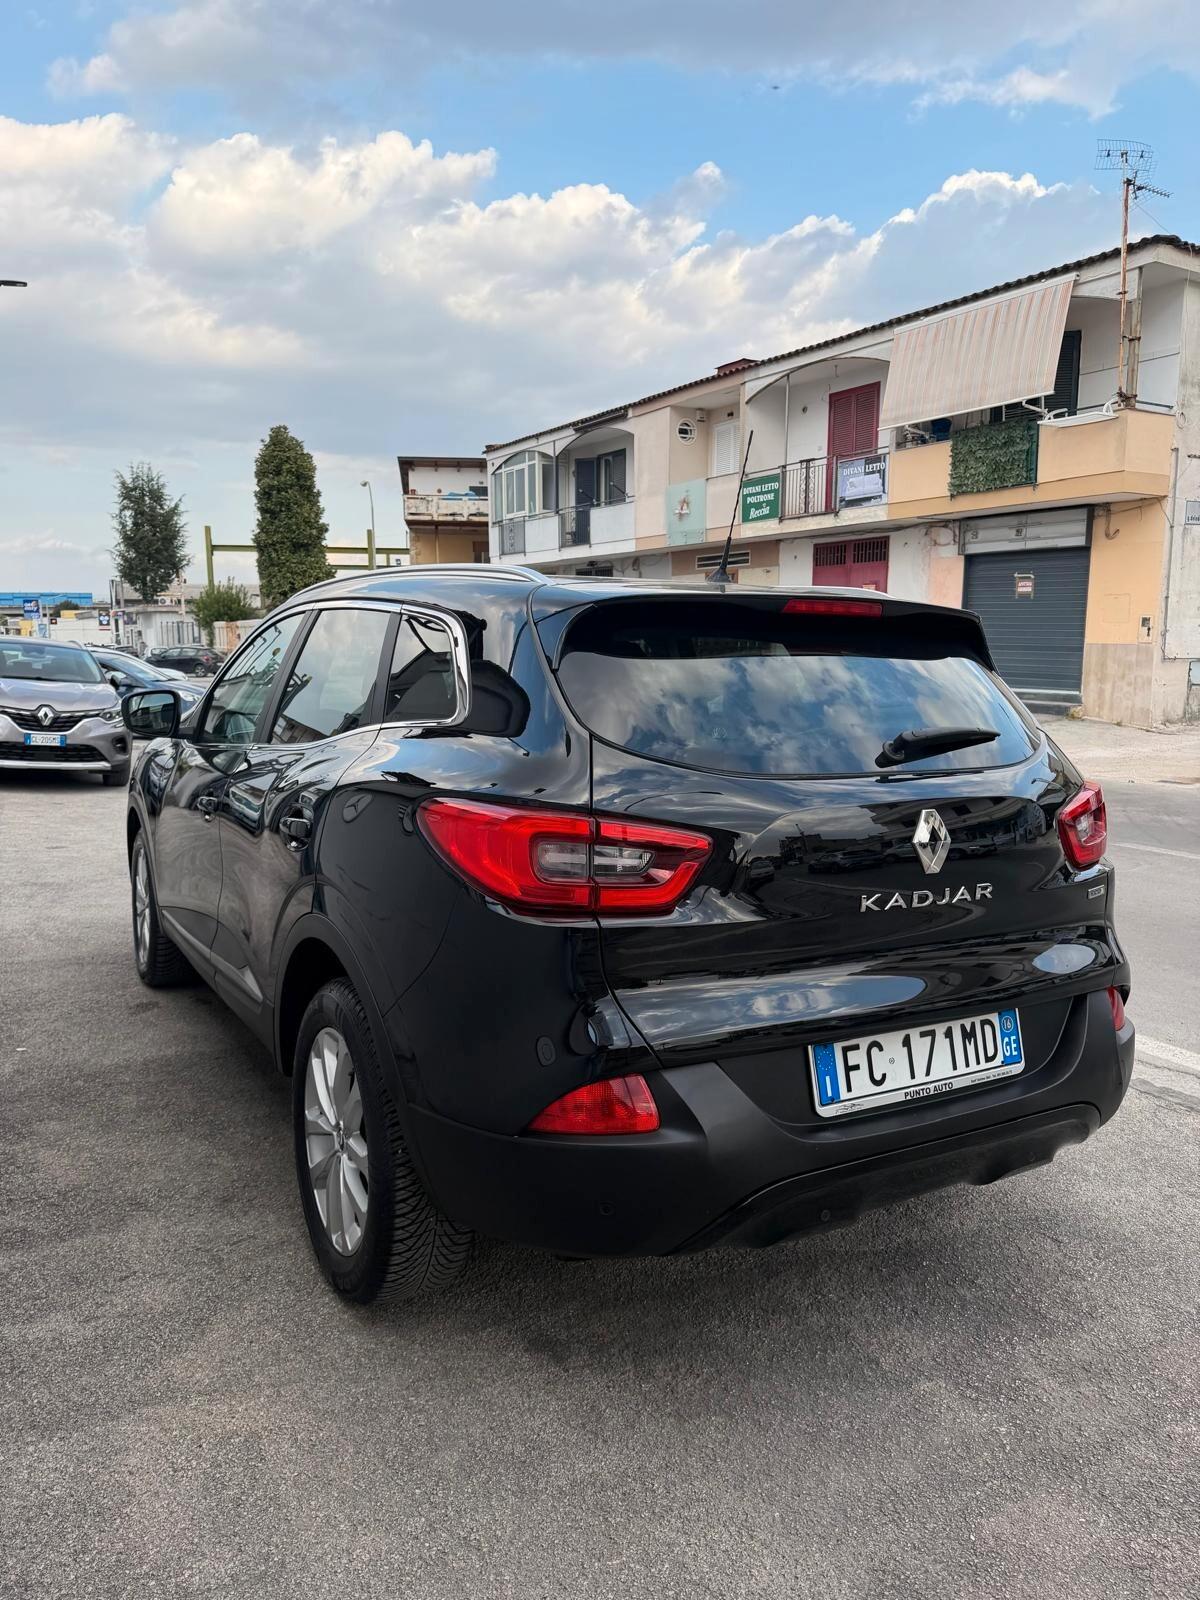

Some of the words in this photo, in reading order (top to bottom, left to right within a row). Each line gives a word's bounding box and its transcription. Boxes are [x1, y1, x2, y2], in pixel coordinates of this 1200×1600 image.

[843, 465, 864, 476] DIVANI
[865, 462, 885, 473] LETTO
[743, 485, 761, 495] DIVANI
[762, 482, 779, 491] LETTO
[746, 492, 775, 505] POLTRONE
[859, 882, 993, 913] KADJAR
[1003, 1018, 1012, 1030] 16
[1003, 1035, 1018, 1057] GE
[841, 1040, 887, 1093] FC
[901, 1018, 999, 1080] 171MD
[825, 1075, 832, 1097] I
[904, 1086, 931, 1100] PUNTO
[933, 1082, 954, 1094] AUTO
